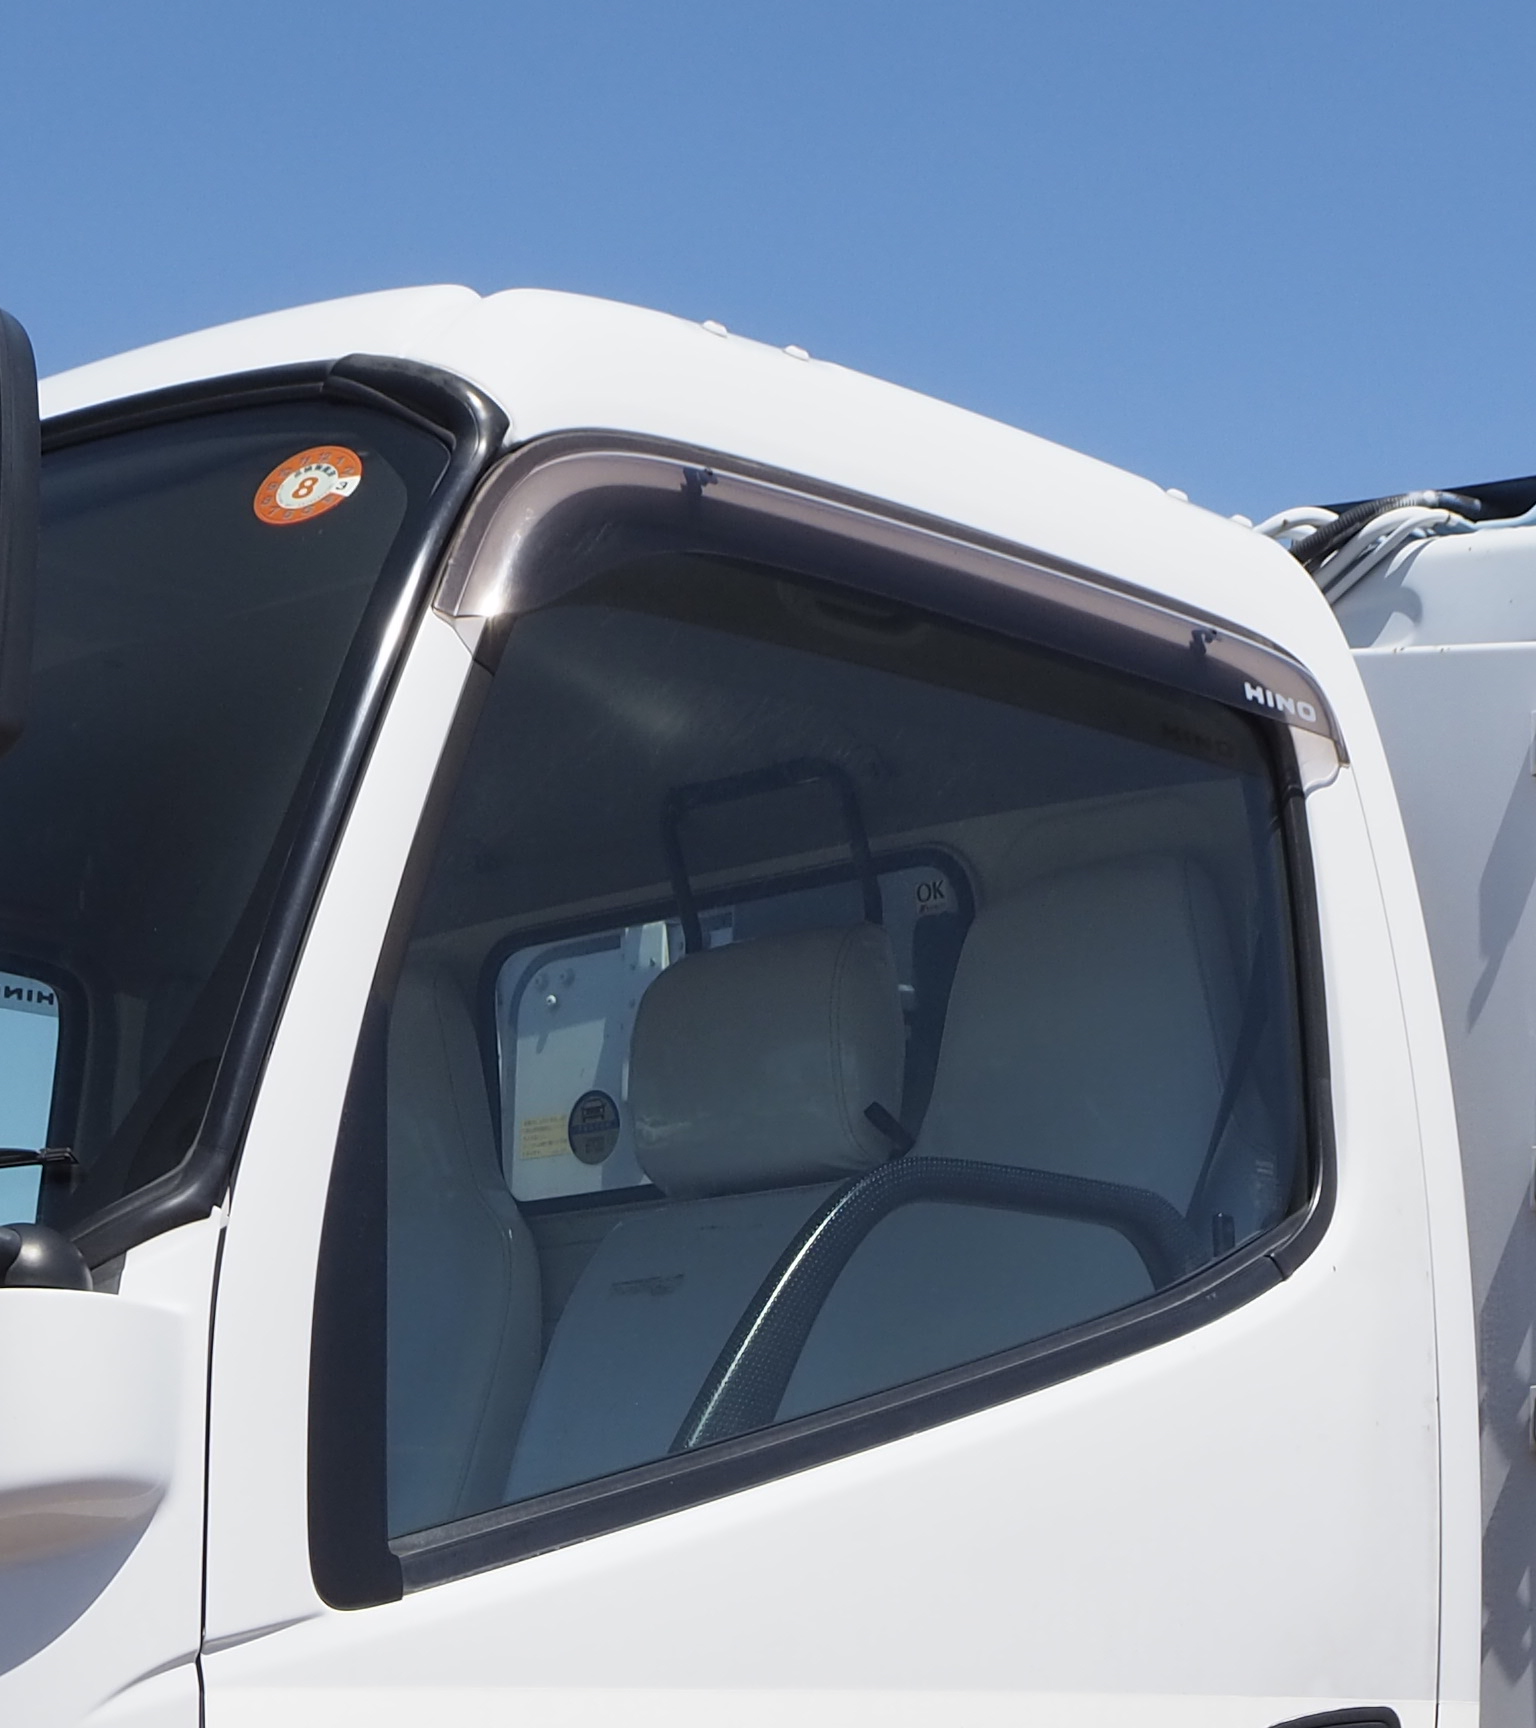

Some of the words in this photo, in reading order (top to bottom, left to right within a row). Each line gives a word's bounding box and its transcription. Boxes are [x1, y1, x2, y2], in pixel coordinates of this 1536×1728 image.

[291, 476, 320, 500] 8
[1243, 681, 1317, 723] HINO
[916, 879, 945, 903] OK
